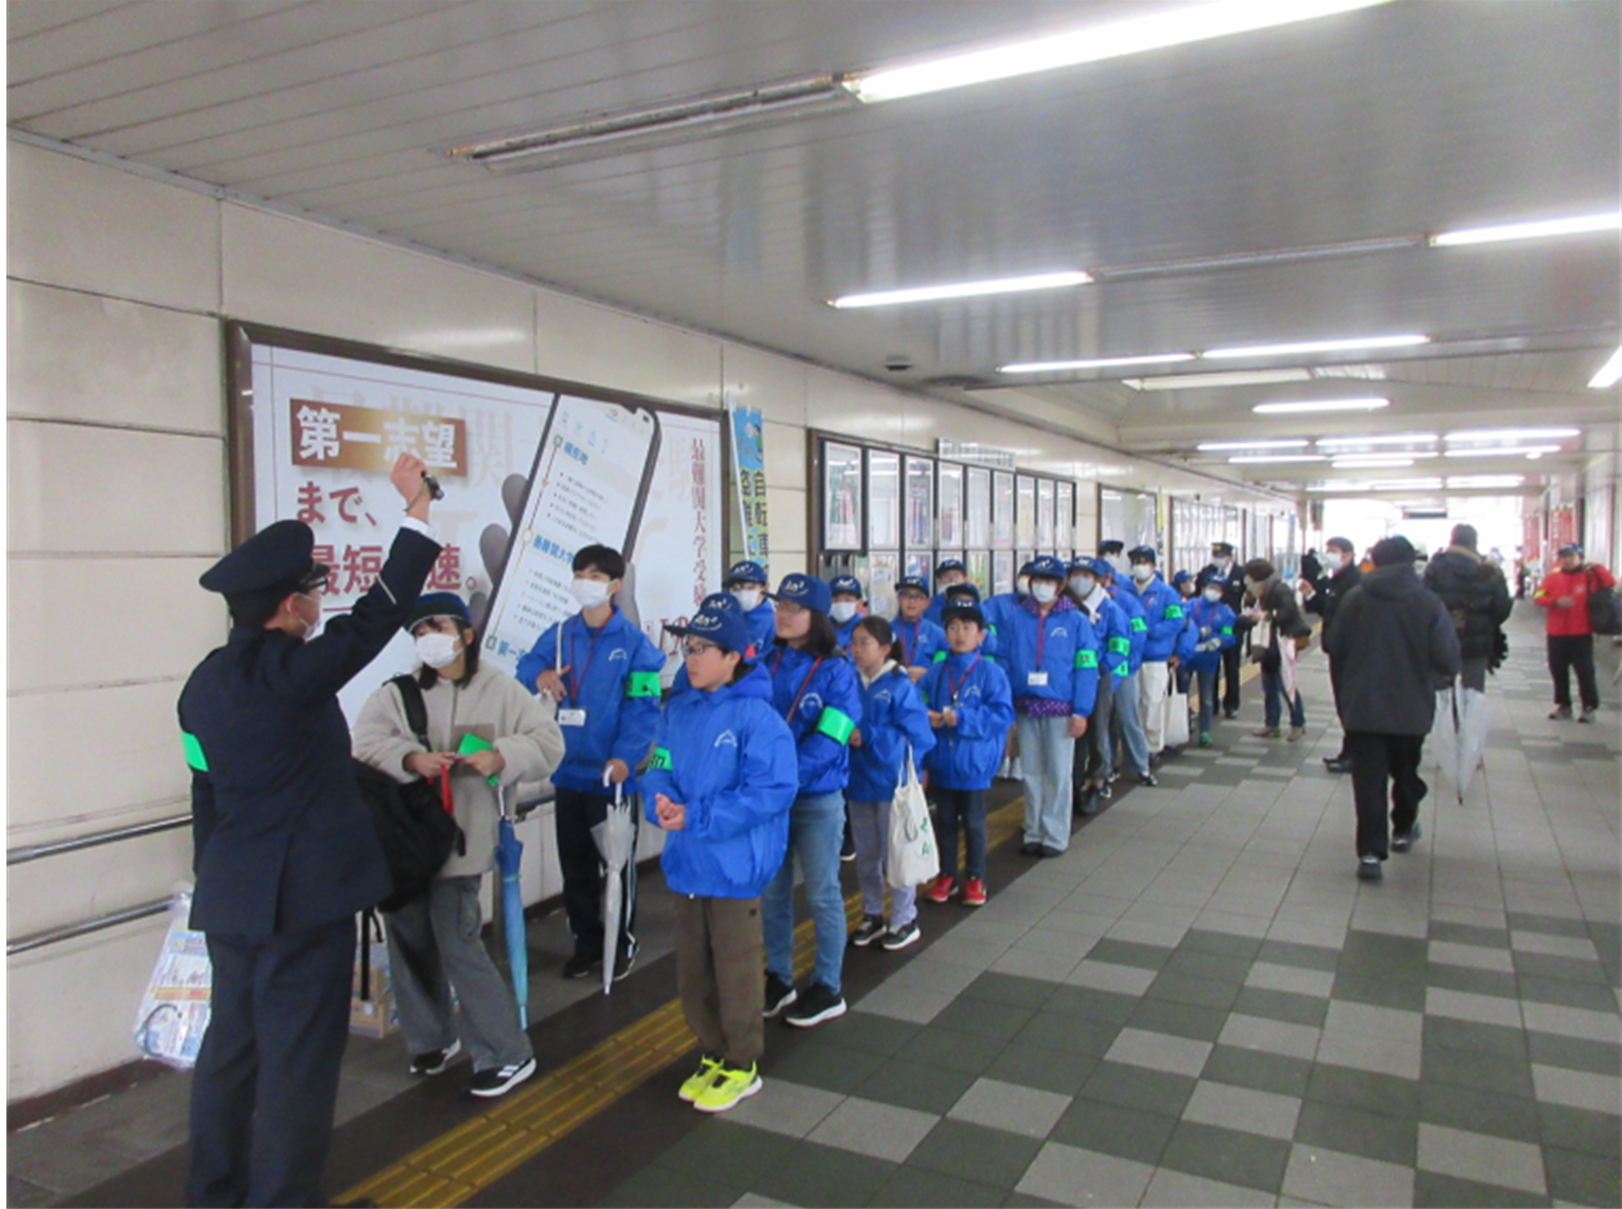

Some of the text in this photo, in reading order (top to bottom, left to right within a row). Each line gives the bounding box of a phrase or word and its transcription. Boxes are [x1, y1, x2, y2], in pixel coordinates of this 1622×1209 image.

[296, 404, 458, 469] 第一志望
[297, 481, 377, 527] まで、
[753, 471, 769, 577] 自転車
[311, 543, 477, 596] 最短速。
